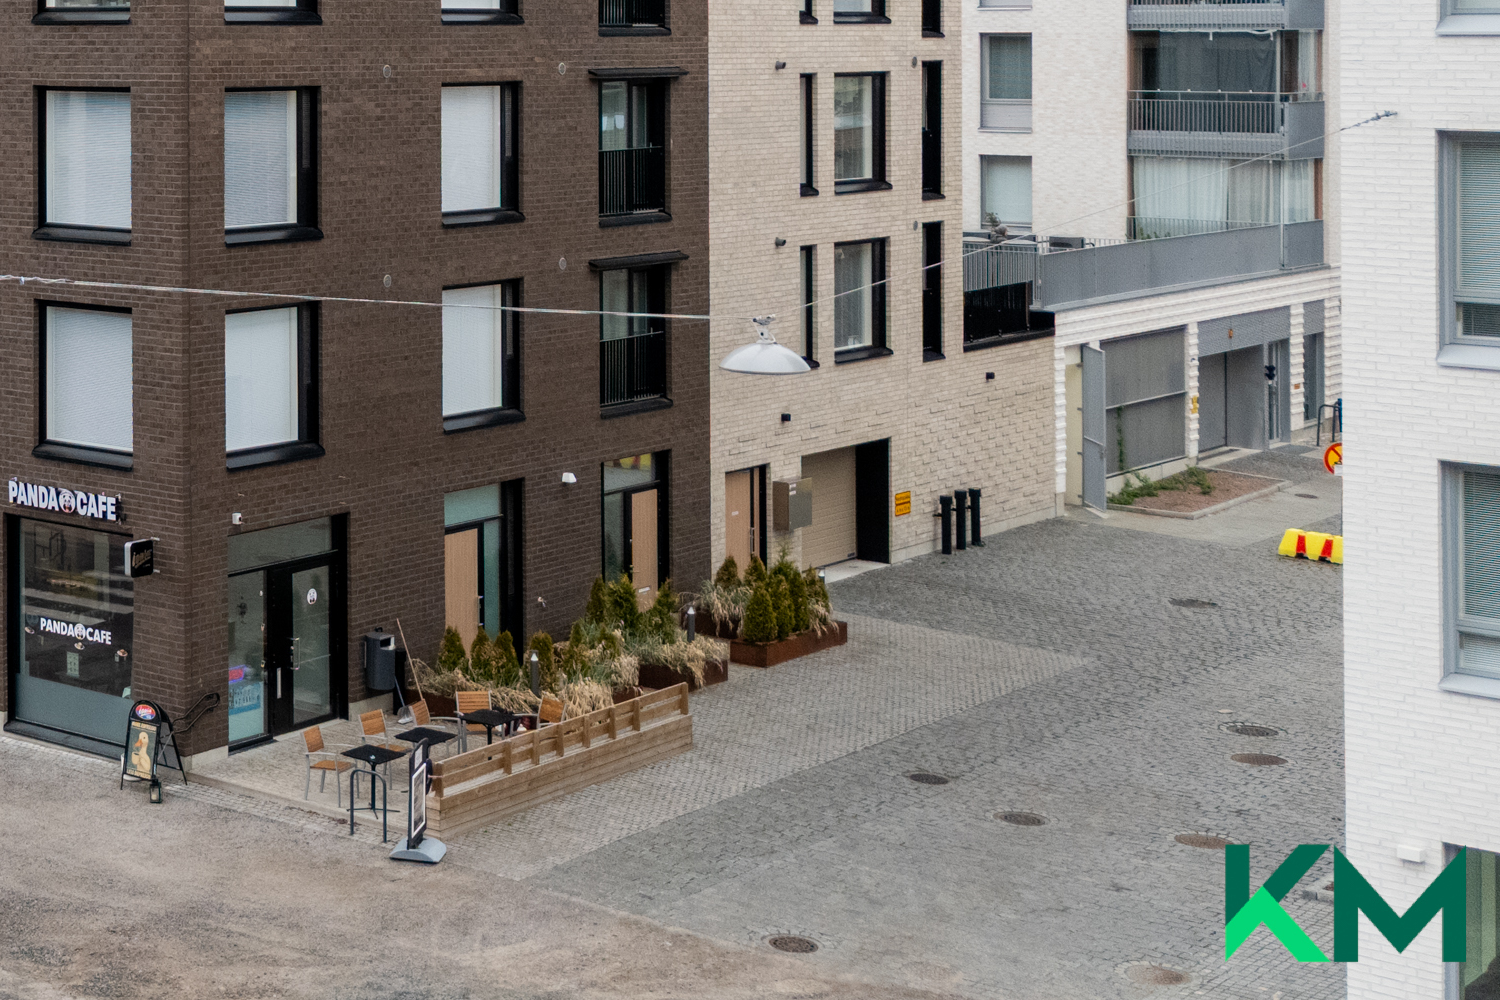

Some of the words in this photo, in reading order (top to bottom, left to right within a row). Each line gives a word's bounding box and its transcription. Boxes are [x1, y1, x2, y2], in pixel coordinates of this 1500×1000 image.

[8, 480, 60, 512] PANDA
[75, 490, 117, 521] CAFE
[40, 617, 75, 637] PANDA
[86, 627, 112, 645] CAFE
